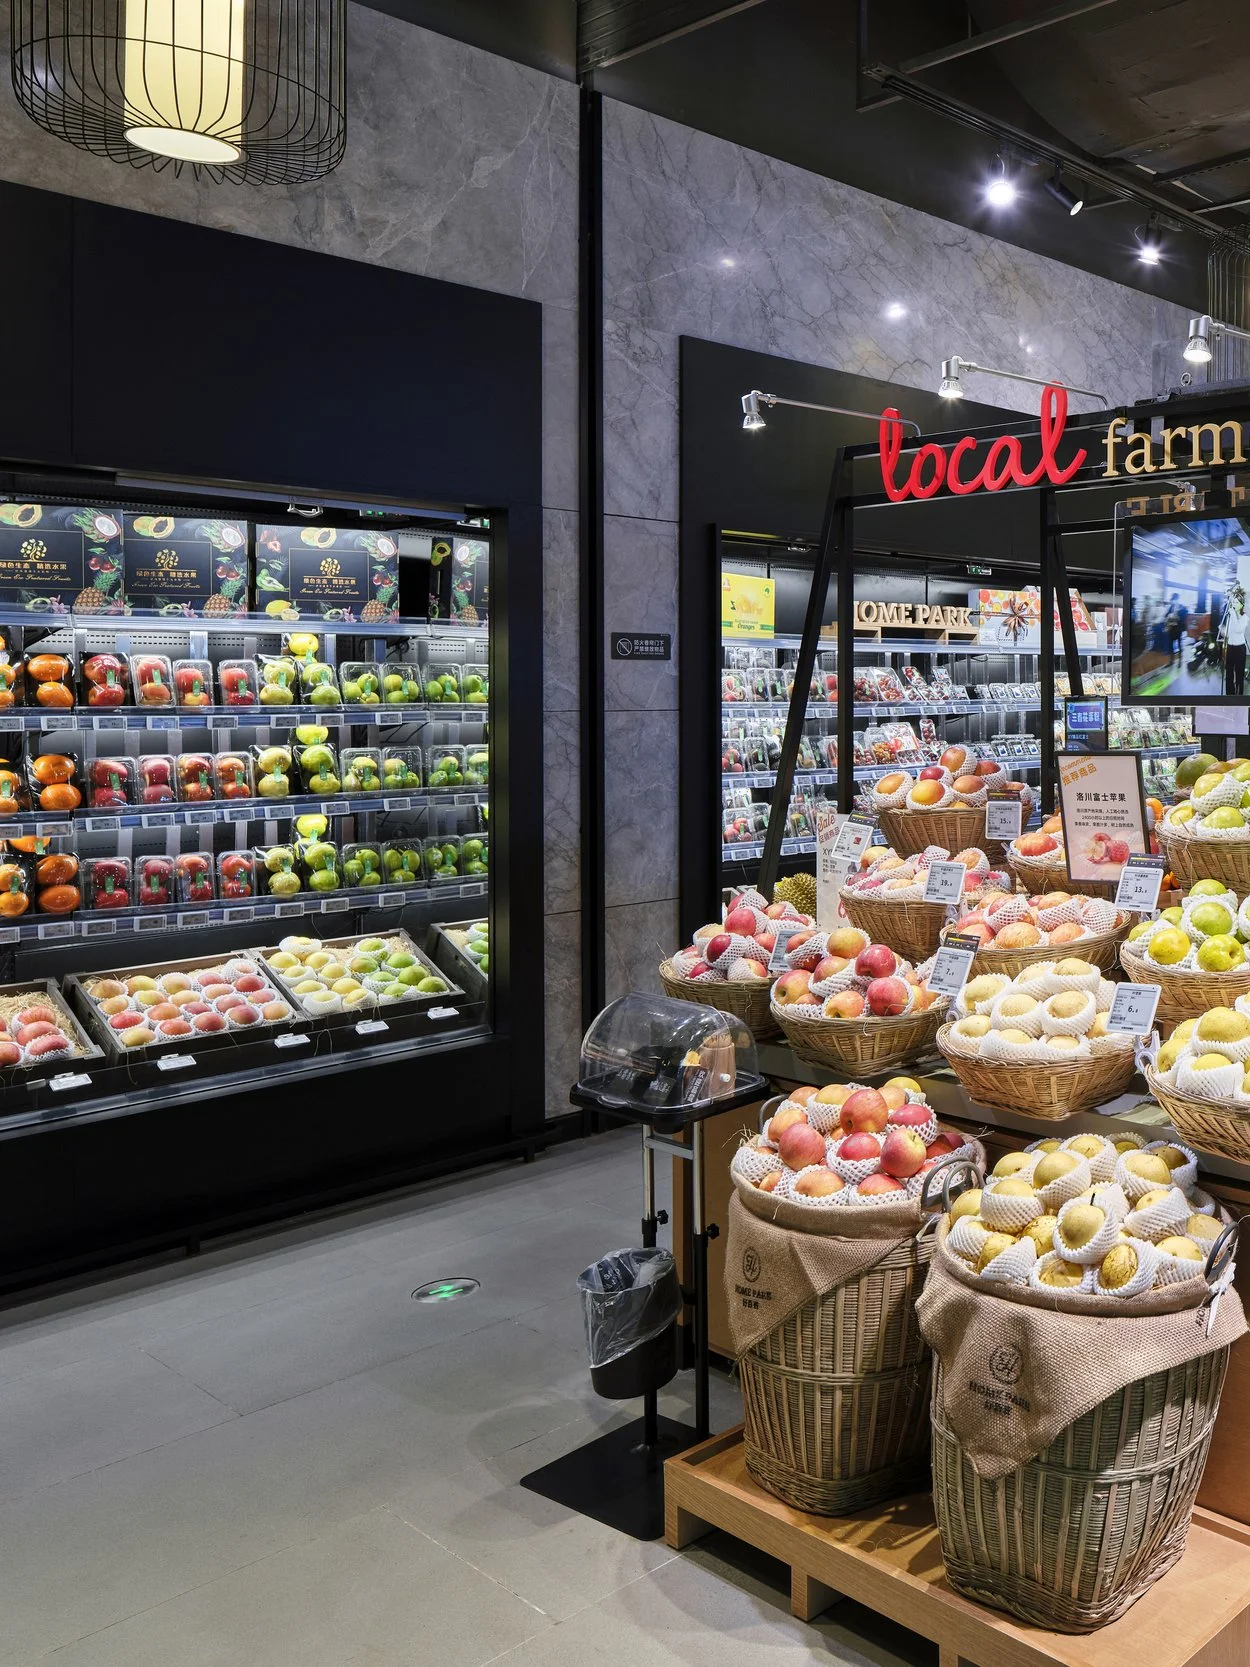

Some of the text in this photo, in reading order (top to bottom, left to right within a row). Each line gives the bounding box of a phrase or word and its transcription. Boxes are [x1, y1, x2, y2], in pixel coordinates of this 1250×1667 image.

[879, 380, 1087, 502] local
[915, 603, 972, 627] PARK
[1062, 763, 1097, 786] 推荐商品
[1076, 792, 1127, 802] 洛川富士苹果
